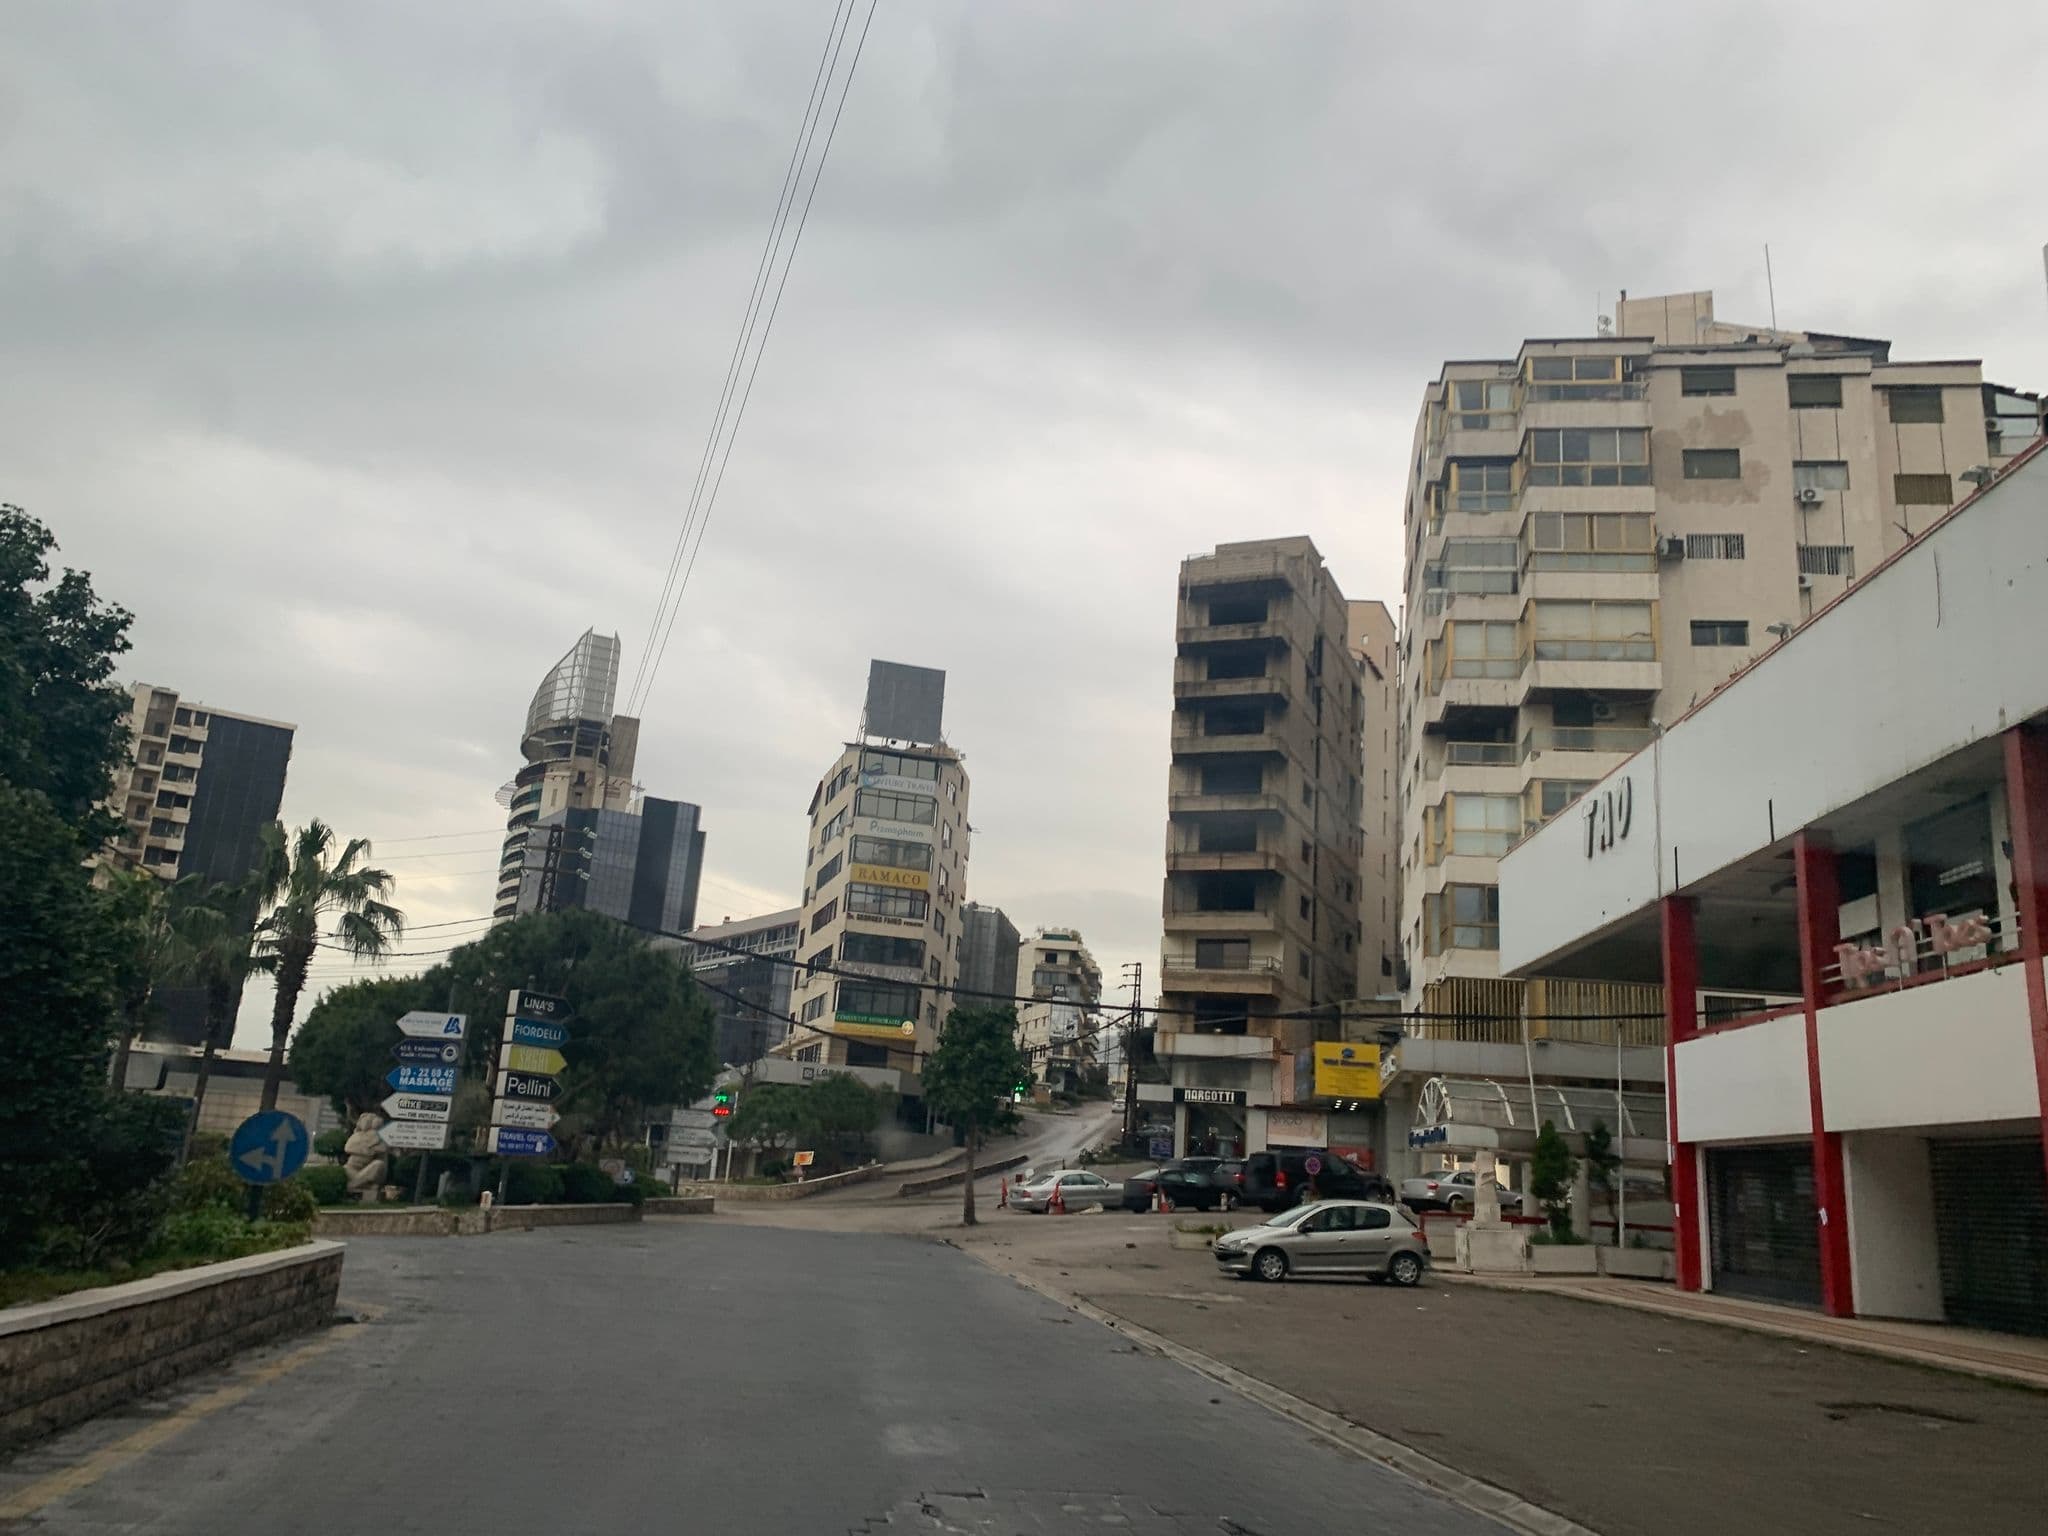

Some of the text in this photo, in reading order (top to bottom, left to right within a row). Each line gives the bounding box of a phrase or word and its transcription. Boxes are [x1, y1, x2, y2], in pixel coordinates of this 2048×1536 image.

[1582, 776, 1632, 858] TAO
[857, 867, 921, 885] RAMACO
[523, 997, 555, 1012] LINA'S
[514, 1024, 562, 1041] FIORDELLI
[398, 1077, 453, 1087] MASSAGE
[443, 1069, 454, 1079] 42
[507, 1077, 552, 1097] Pellini
[499, 1132, 526, 1142] TRAVEL
